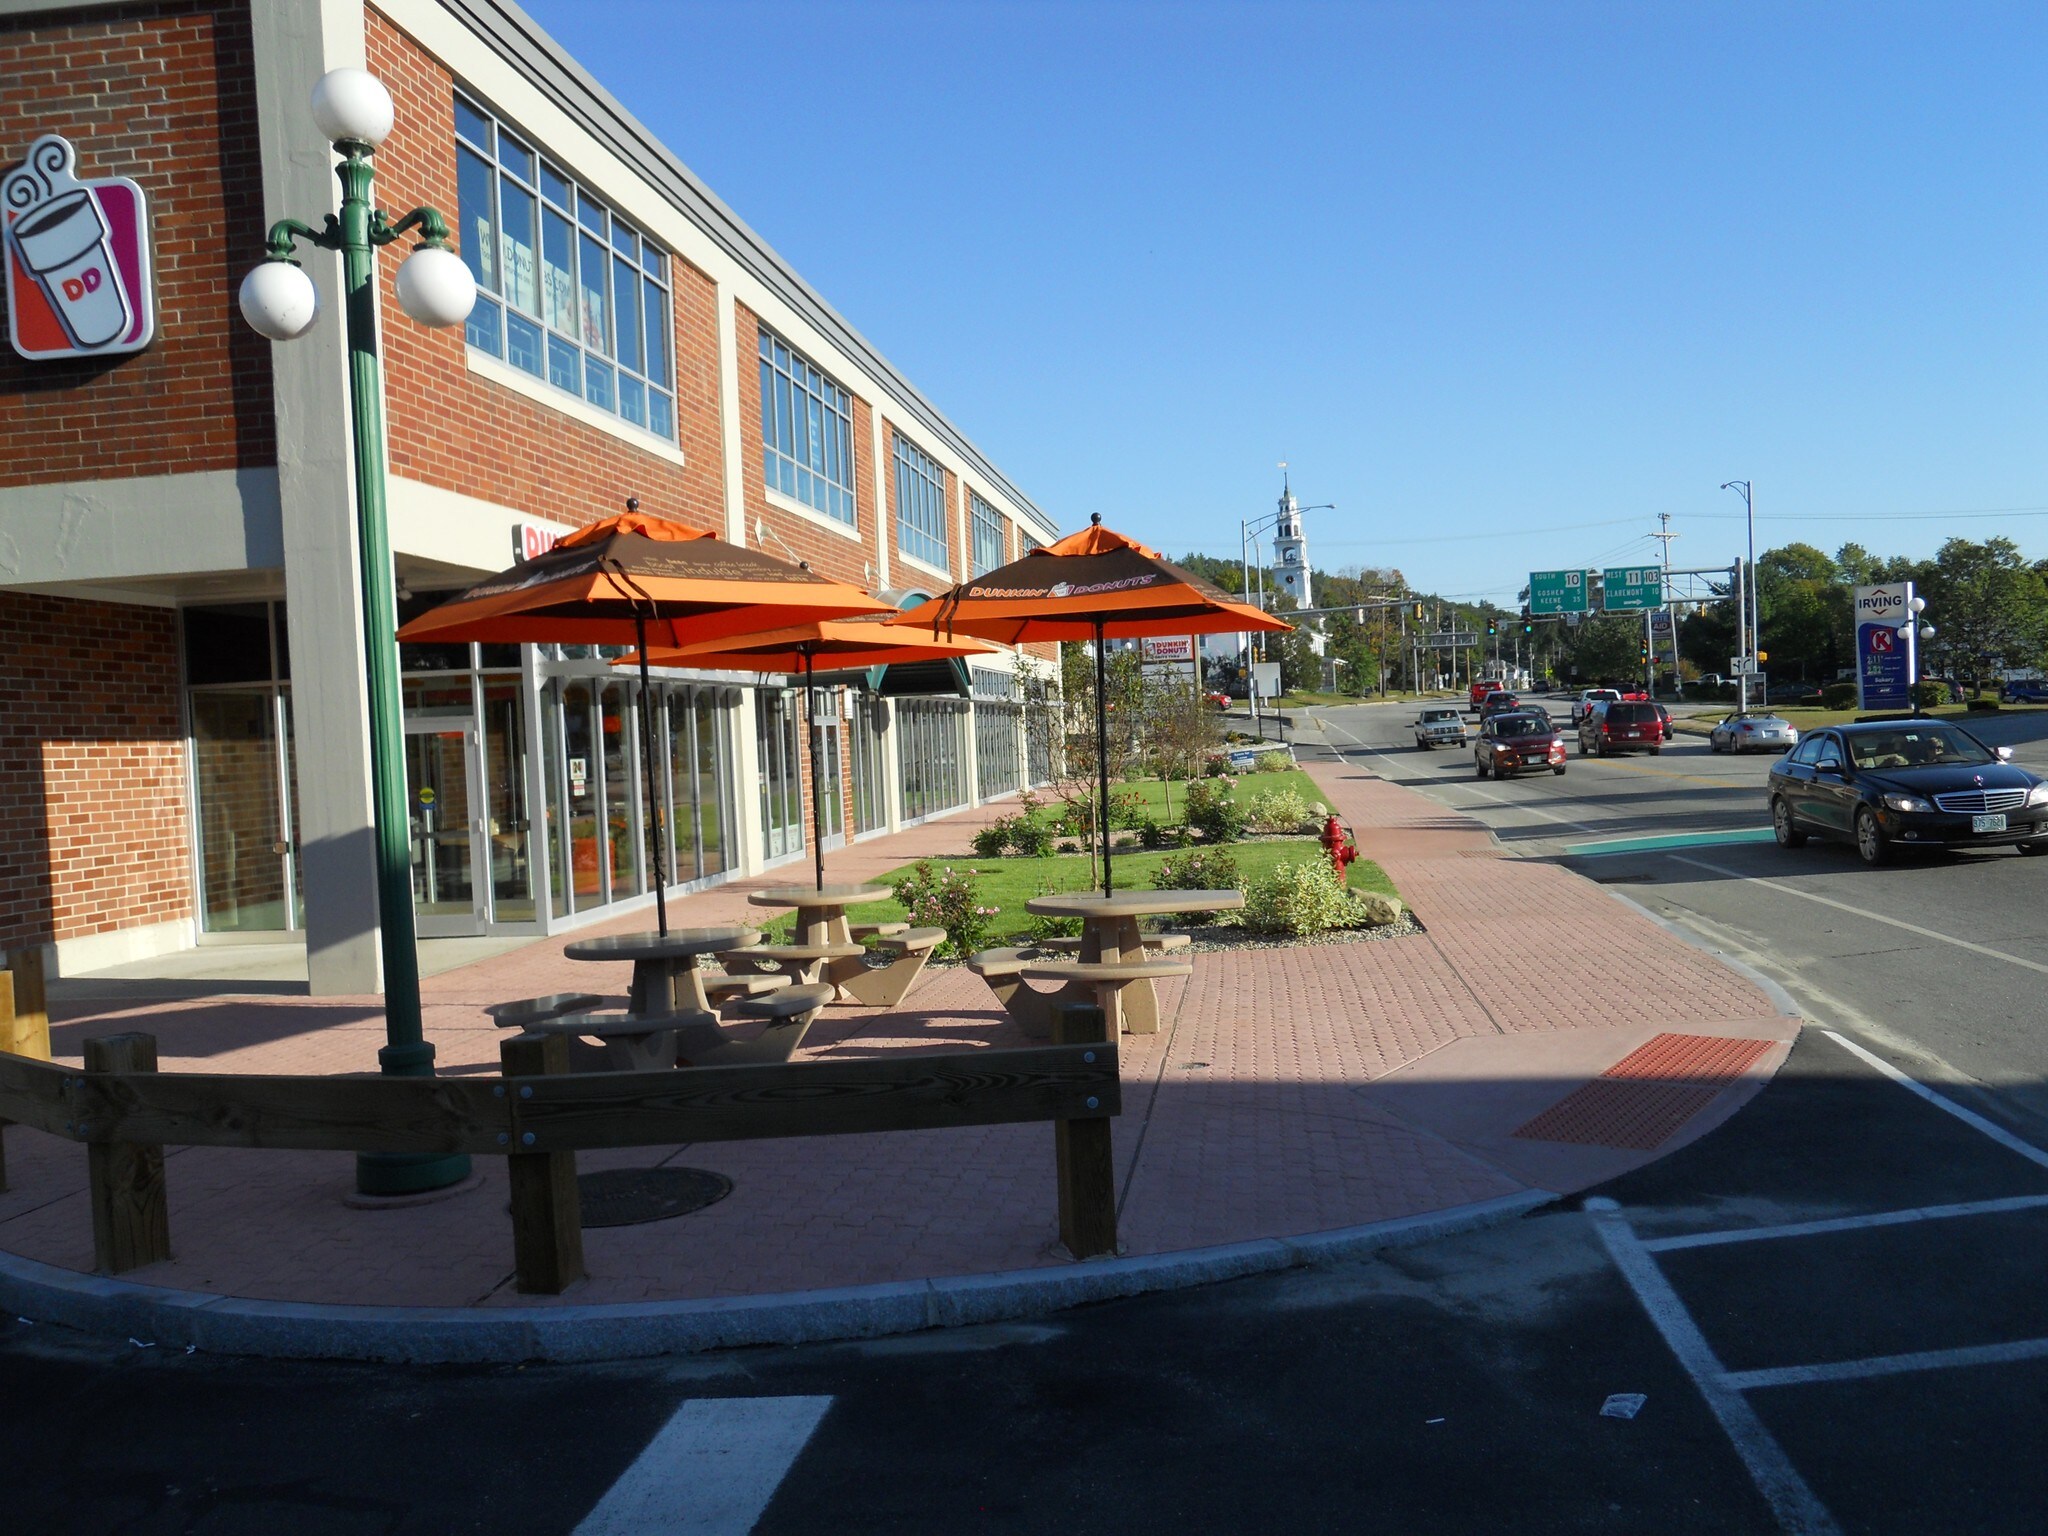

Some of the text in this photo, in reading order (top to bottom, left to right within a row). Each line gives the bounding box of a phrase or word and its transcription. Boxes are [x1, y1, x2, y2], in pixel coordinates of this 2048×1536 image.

[61, 267, 101, 302] DD
[1566, 574, 1579, 585] 10
[1606, 571, 1659, 584] WEST 11 103
[969, 575, 1154, 598] DUNKIN' DONUTS
[1606, 588, 1643, 597] CLAREMONT
[1858, 595, 1902, 609] IRVING
[1652, 615, 1669, 623] RITE
[1156, 640, 1189, 648] DUNKIN'
[1875, 632, 1891, 651] K
[1156, 647, 1188, 655] DONUTS
